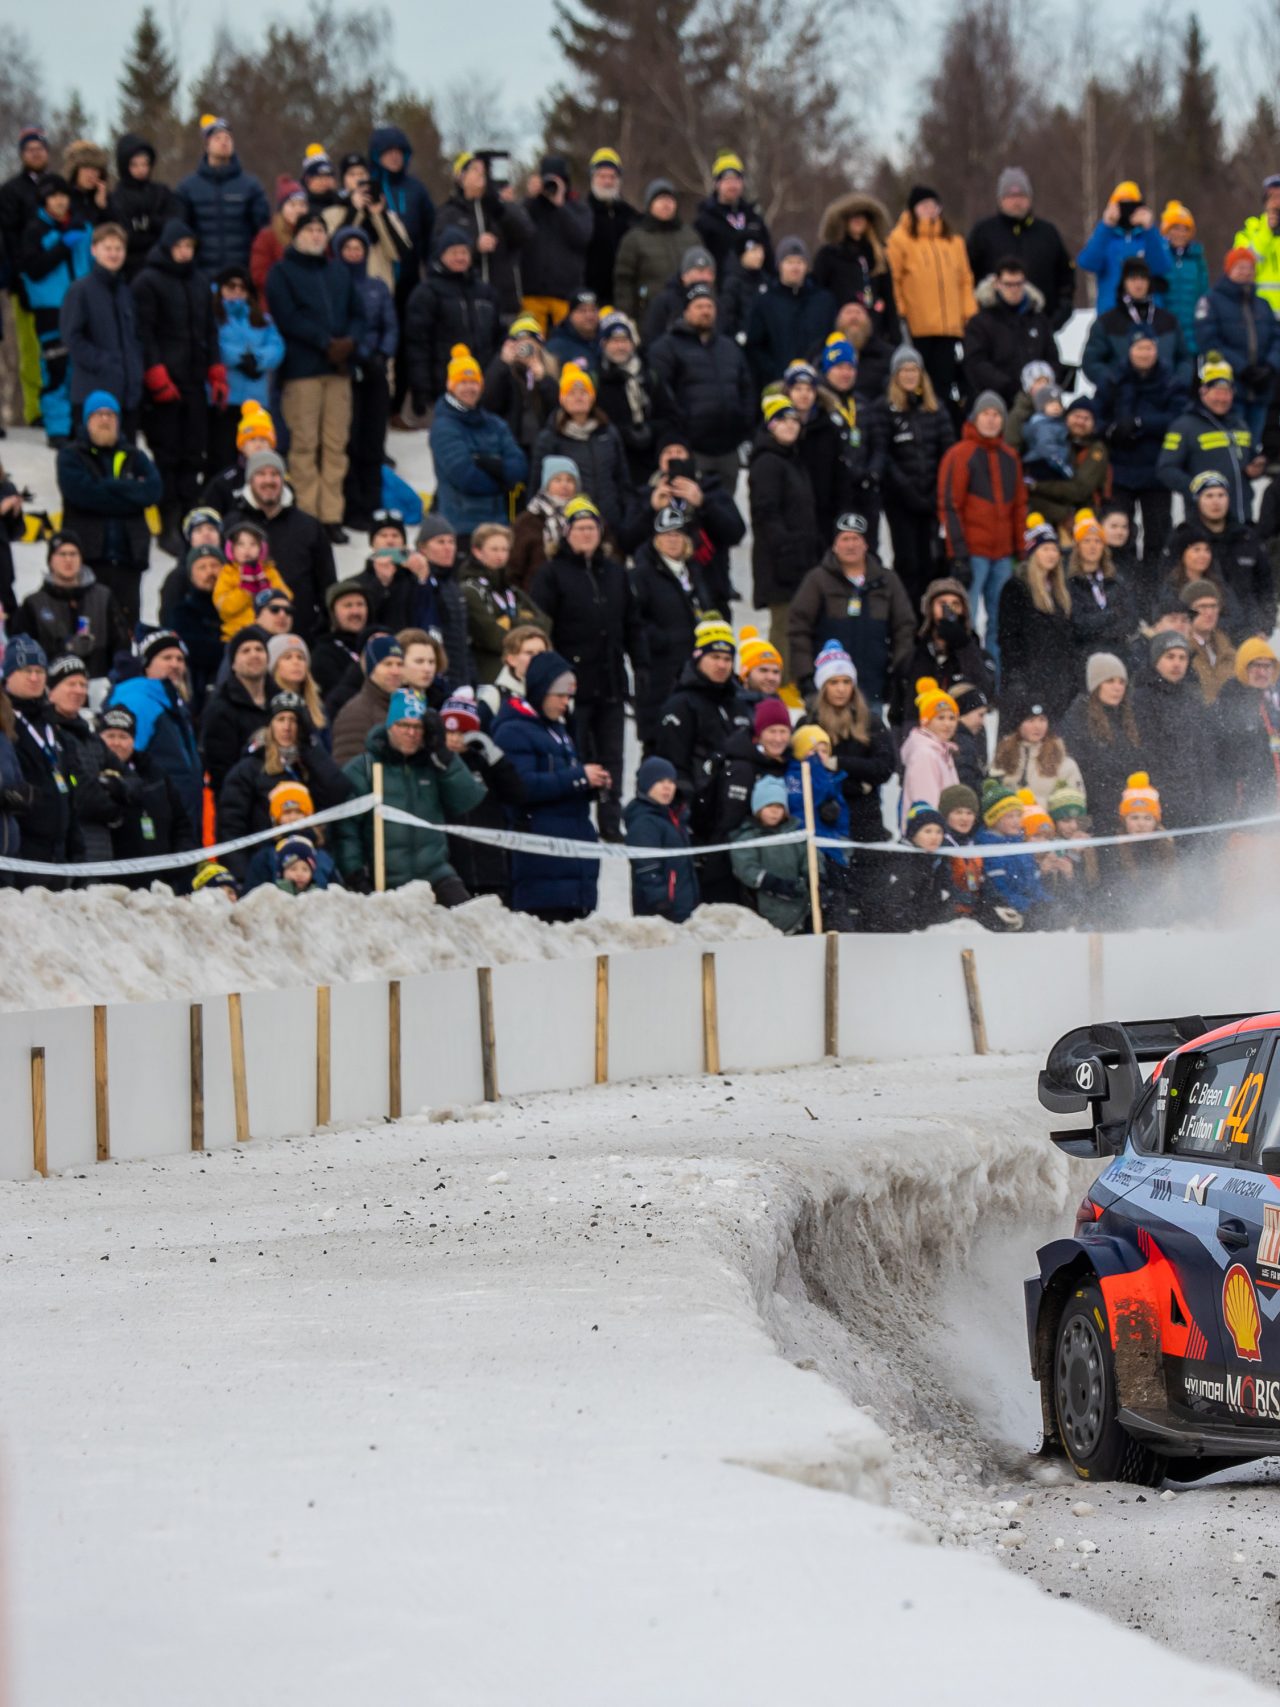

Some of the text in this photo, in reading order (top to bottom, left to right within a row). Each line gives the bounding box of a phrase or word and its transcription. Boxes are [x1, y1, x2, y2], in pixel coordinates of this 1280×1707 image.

[1189, 1082, 1200, 1104] C.
[1198, 1083, 1223, 1106] Breen
[1225, 1072, 1264, 1144] 42
[1178, 1114, 1213, 1139] J. Fulton
[1222, 1177, 1266, 1199] INNOCEAN
[1184, 1377, 1224, 1402] HYUNDAI
